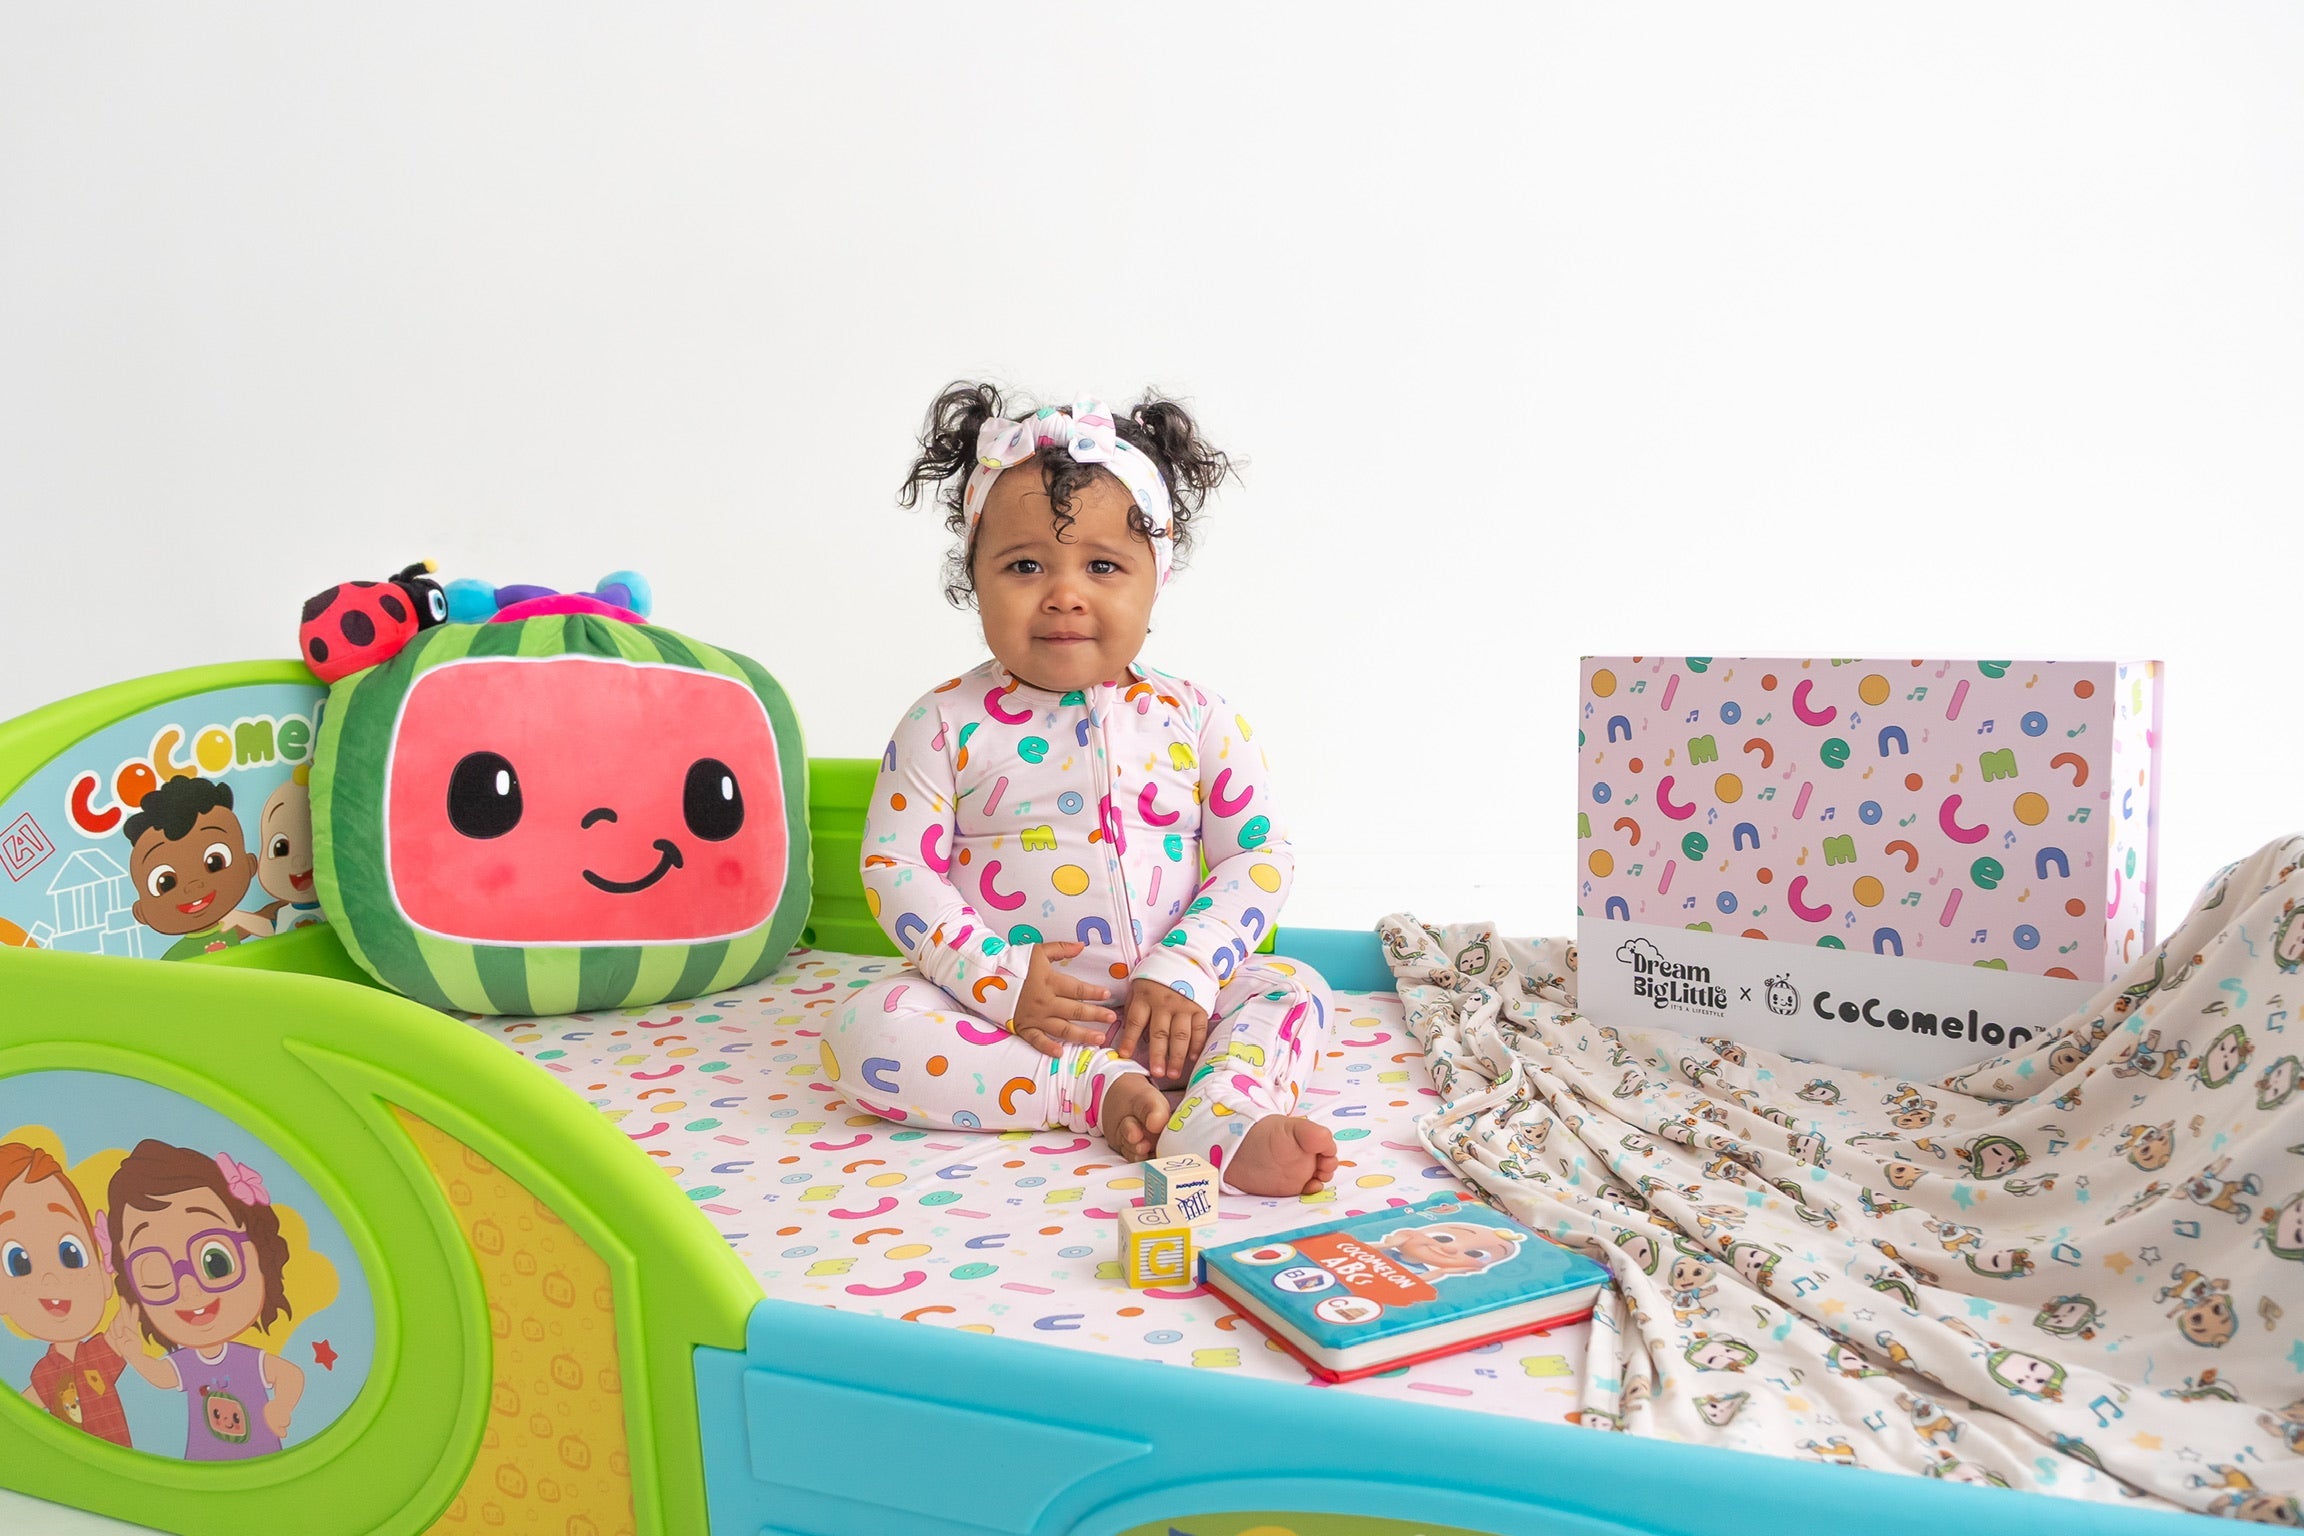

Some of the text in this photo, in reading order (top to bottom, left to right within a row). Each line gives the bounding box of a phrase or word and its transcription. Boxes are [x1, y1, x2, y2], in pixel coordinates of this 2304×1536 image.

[1633, 952, 1711, 984] Dream
[1691, 1008, 1725, 1018] LIFESTYLE
[1148, 1241, 1177, 1275] C
[1335, 1242, 1417, 1289] COCOMELON
